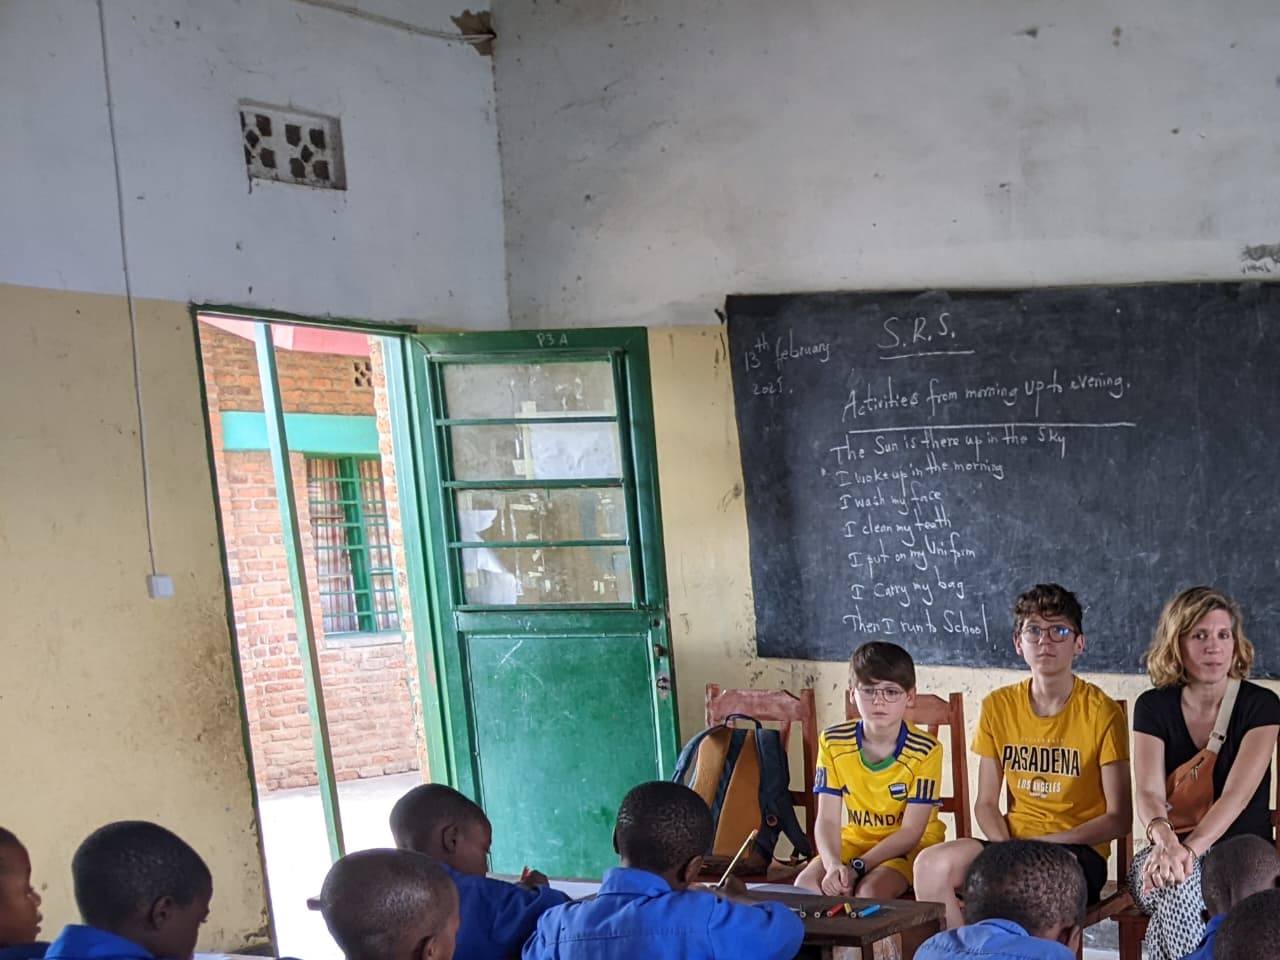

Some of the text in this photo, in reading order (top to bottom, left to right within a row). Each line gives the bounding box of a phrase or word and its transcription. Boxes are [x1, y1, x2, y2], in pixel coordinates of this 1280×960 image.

[841, 376, 919, 422] Activities
[926, 378, 958, 416] from
[965, 382, 1019, 406] morning
[830, 434, 865, 465] The
[903, 434, 917, 449] is
[920, 428, 960, 449] there
[965, 435, 984, 462] up
[986, 431, 1000, 444] in
[1002, 425, 1028, 446] the
[836, 470, 852, 487] I
[908, 463, 924, 477] in
[925, 450, 949, 474] the
[953, 459, 1004, 480] morning
[839, 494, 852, 510] I
[855, 486, 886, 509] wash
[910, 480, 942, 516] face
[844, 504, 952, 547] I clean my teeth
[848, 551, 863, 568] I
[867, 538, 890, 579] put
[895, 553, 907, 563] on
[909, 549, 928, 571] my
[851, 583, 864, 600] I
[912, 583, 934, 606] my
[934, 565, 966, 599] bag
[842, 604, 880, 634] Then
[881, 617, 897, 635] I
[900, 620, 924, 634] run
[1002, 744, 1081, 777] PASADENA
[1016, 777, 1062, 794] LOS ANGELES
